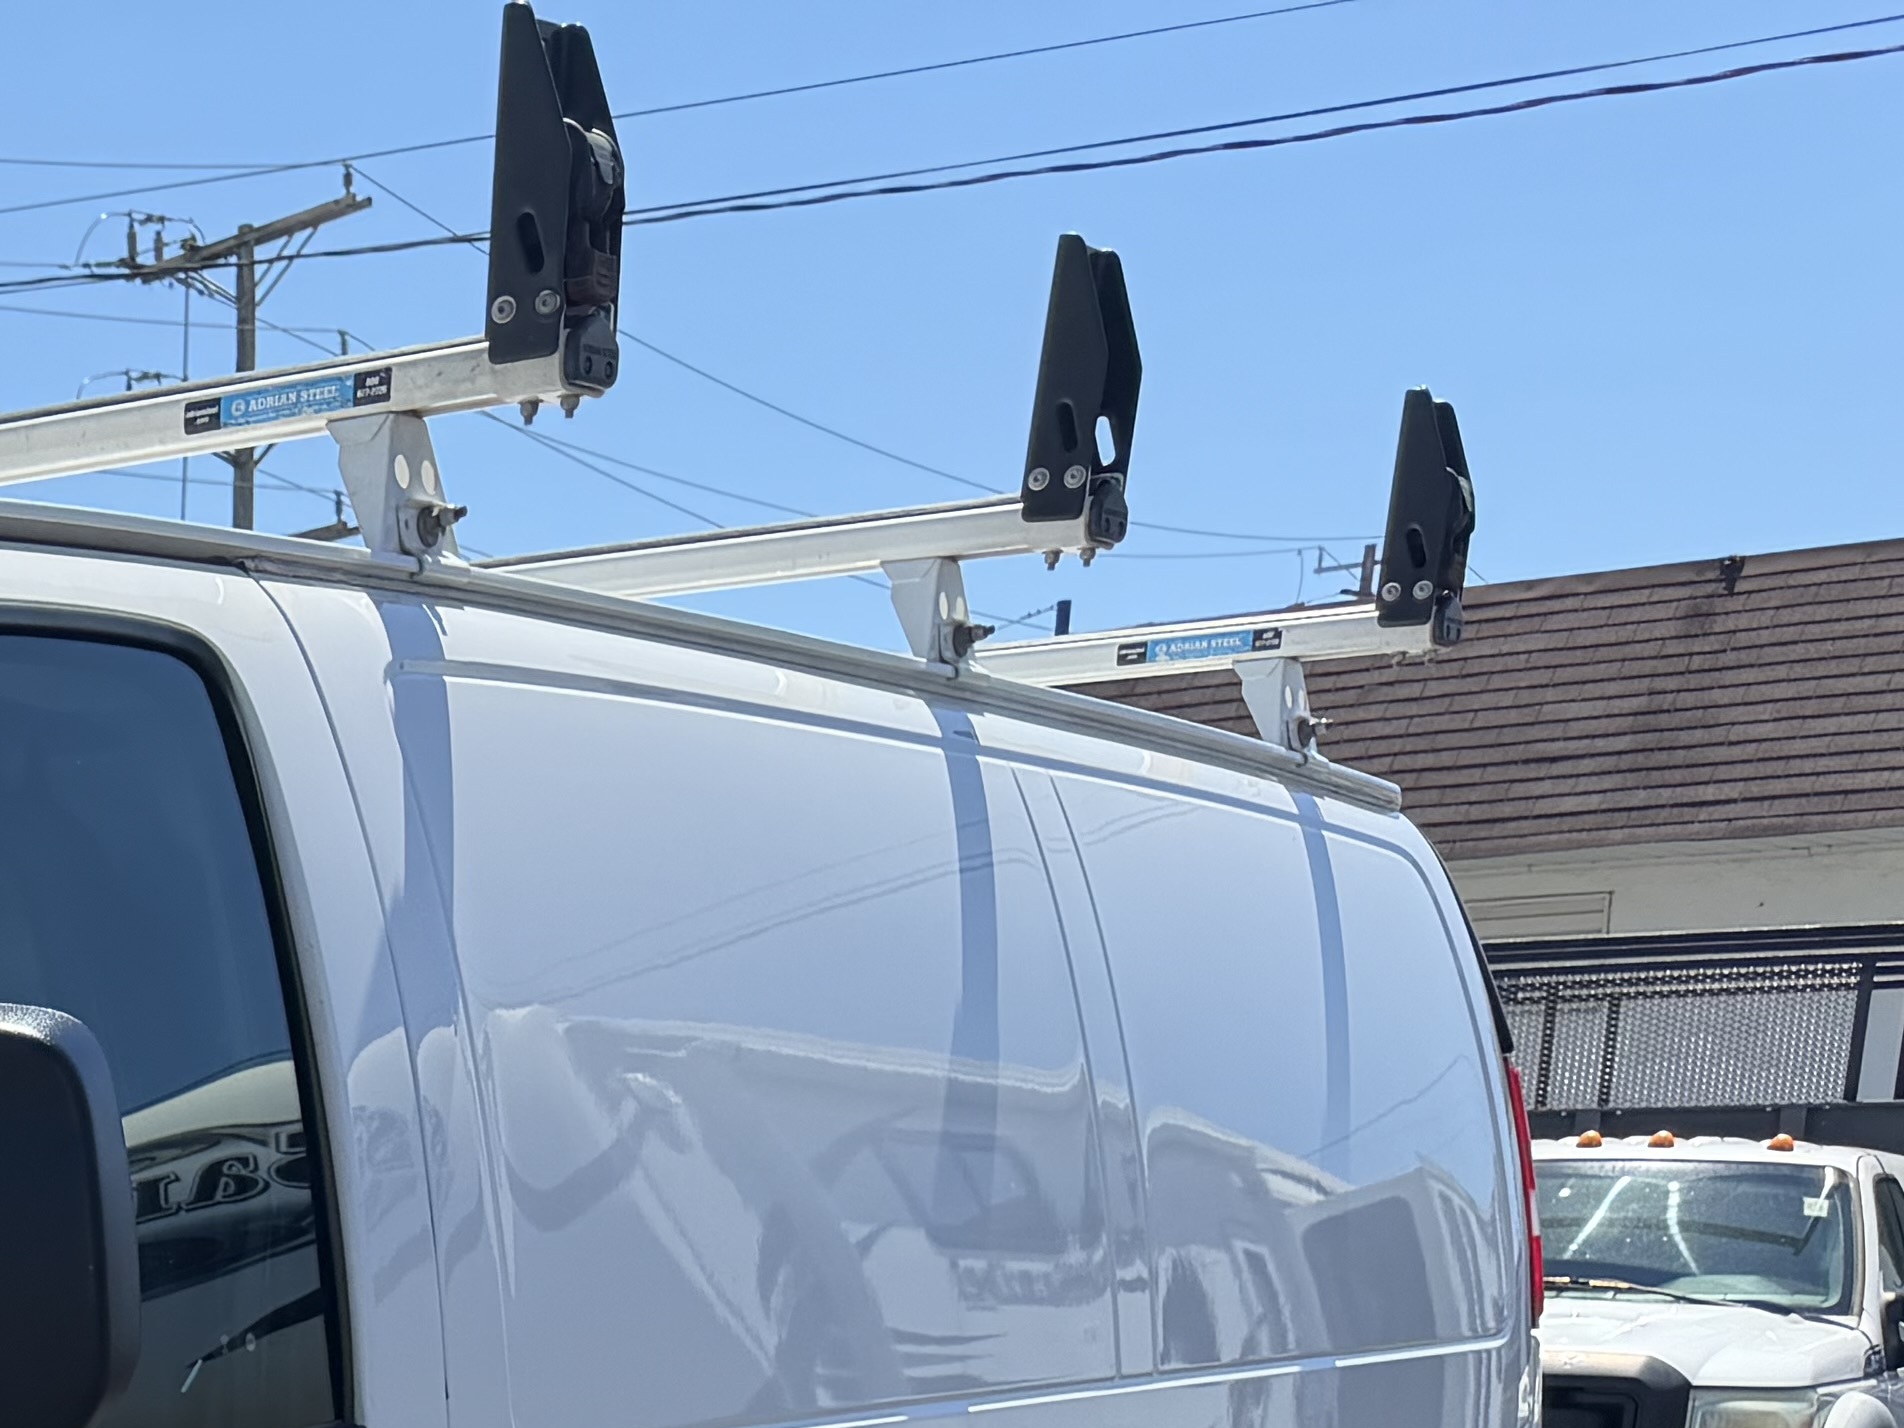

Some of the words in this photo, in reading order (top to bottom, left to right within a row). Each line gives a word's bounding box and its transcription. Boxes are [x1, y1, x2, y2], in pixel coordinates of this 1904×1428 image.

[248, 391, 297, 412] ADRIAN
[300, 385, 339, 402] STEEL
[1169, 642, 1208, 652] ADRIAN
[1211, 637, 1241, 648] STEEL
